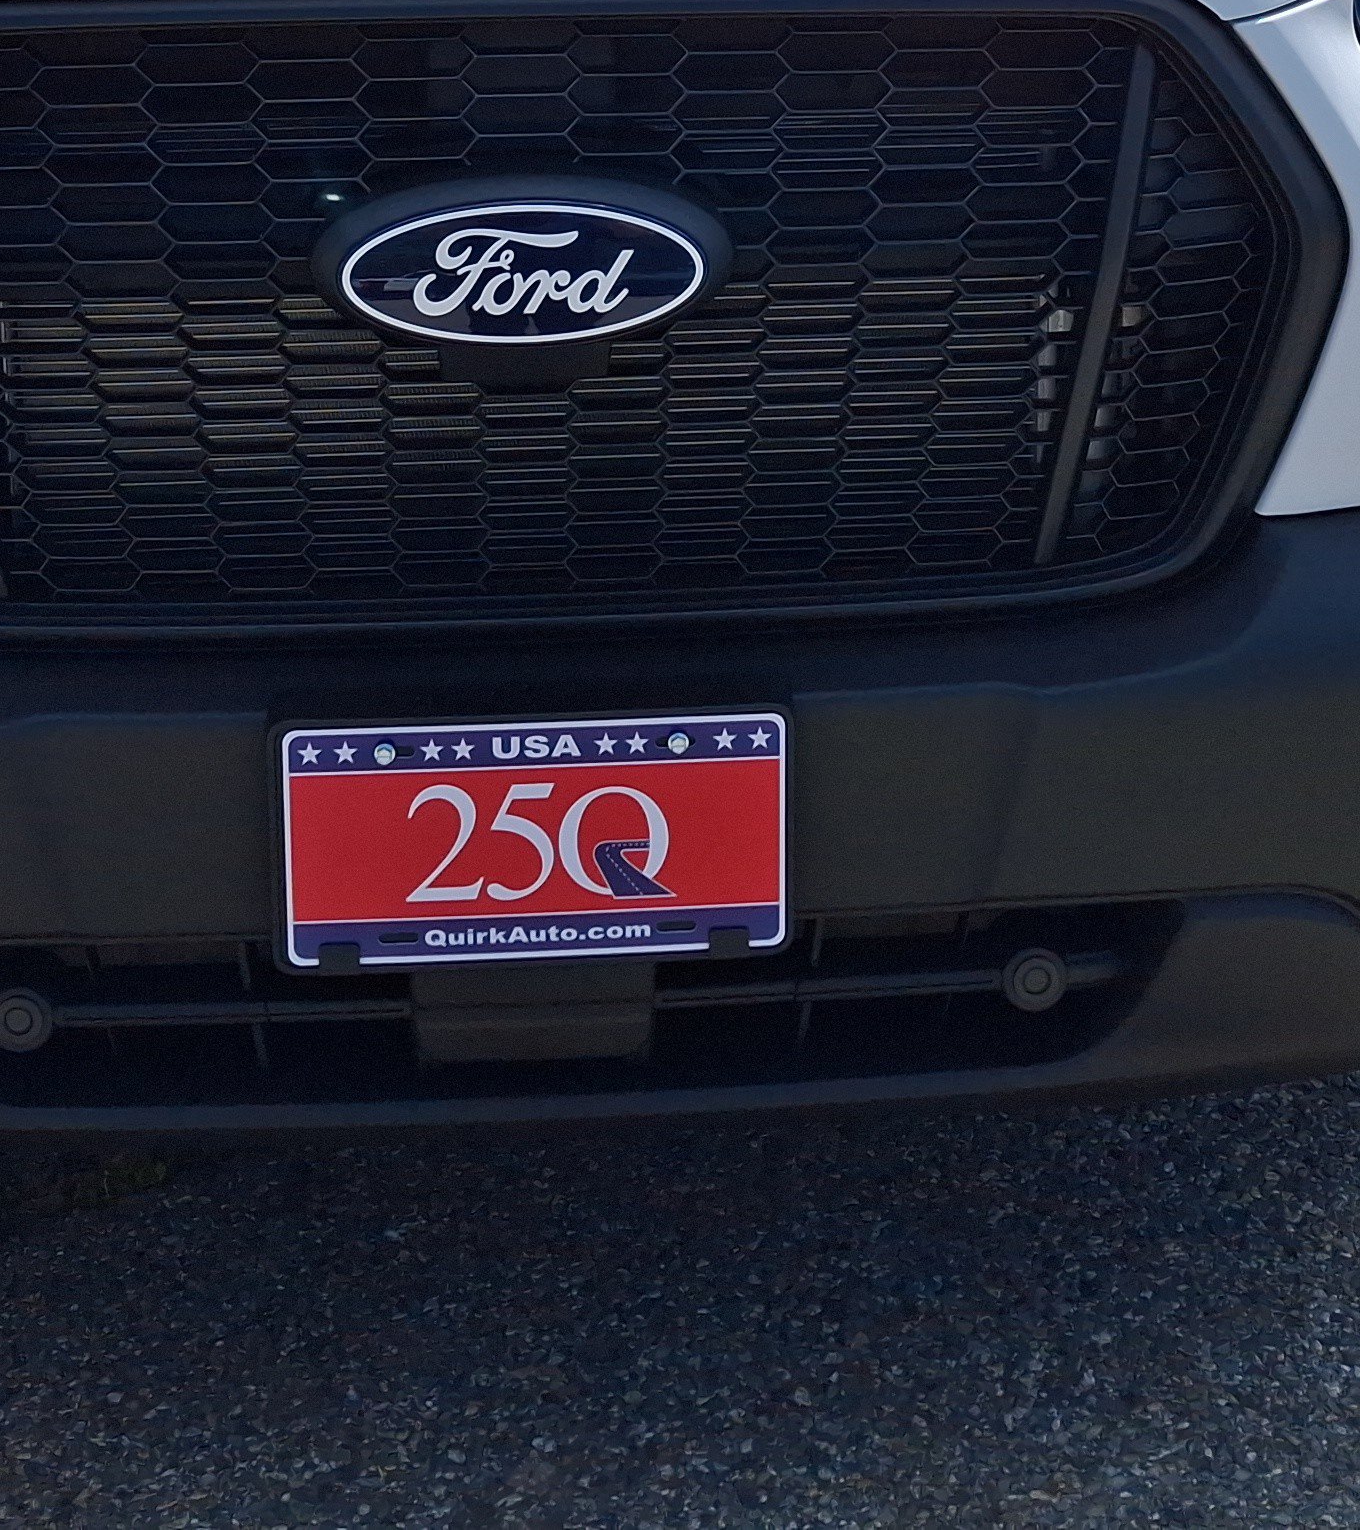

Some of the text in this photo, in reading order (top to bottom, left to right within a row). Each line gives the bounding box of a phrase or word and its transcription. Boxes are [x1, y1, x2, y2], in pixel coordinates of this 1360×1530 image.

[413, 227, 635, 317] Ford
[491, 734, 582, 759] USA
[424, 920, 652, 949] QuirkAuto.com
